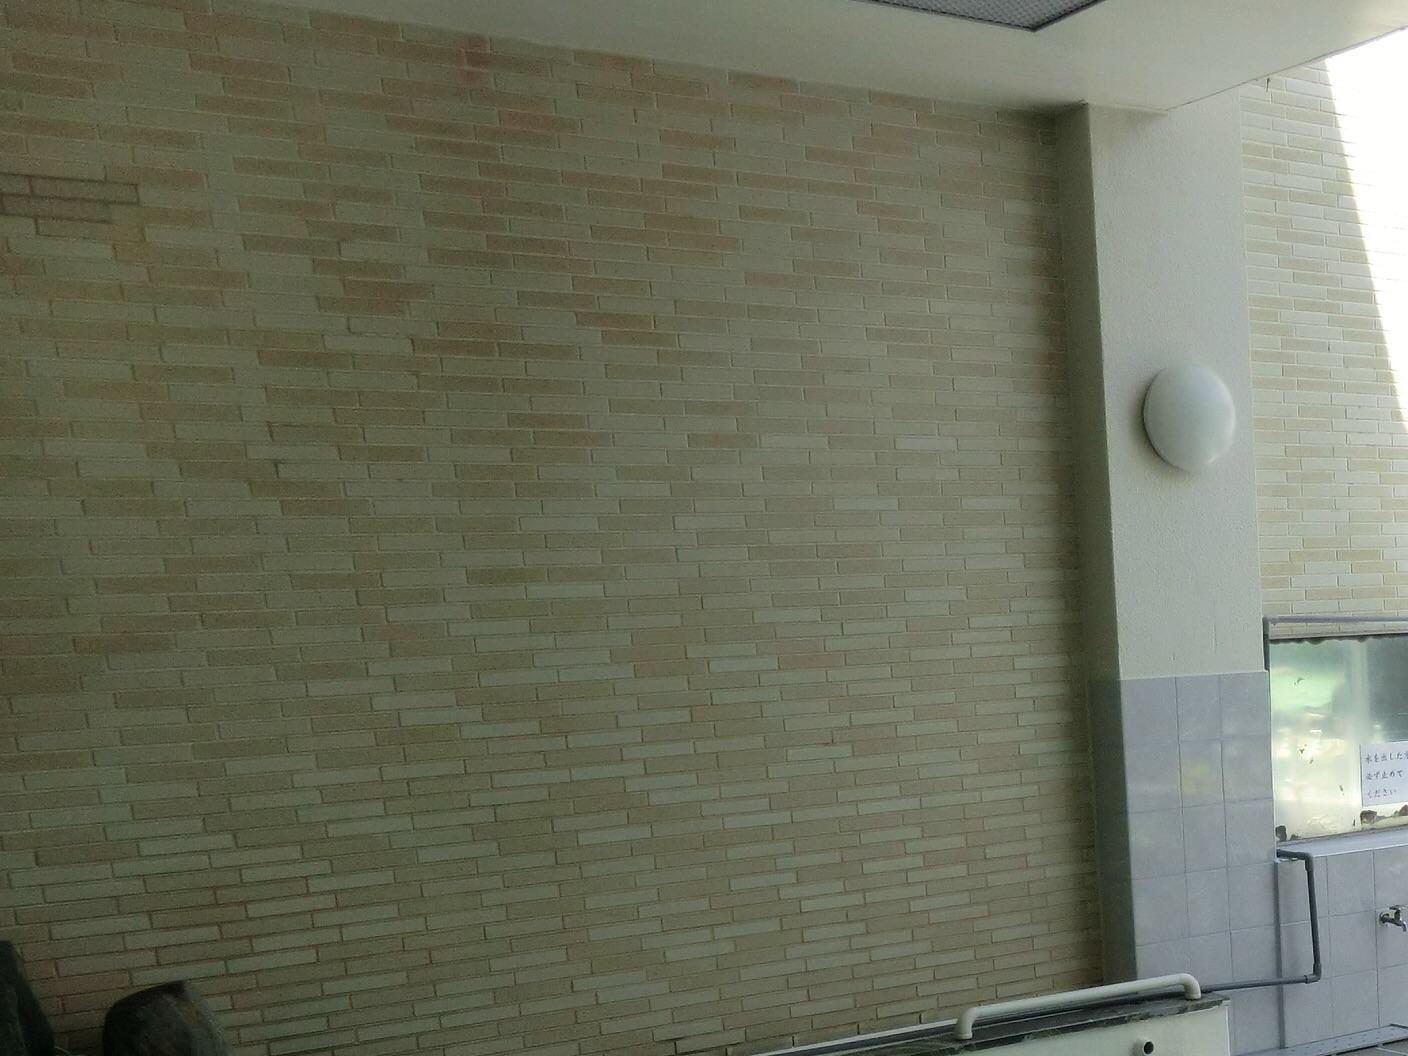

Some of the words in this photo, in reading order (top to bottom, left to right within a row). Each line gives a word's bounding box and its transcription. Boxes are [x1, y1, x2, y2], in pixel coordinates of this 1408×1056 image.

[1366, 769, 1403, 780] 必ず止めて
[1367, 787, 1397, 799] ください
